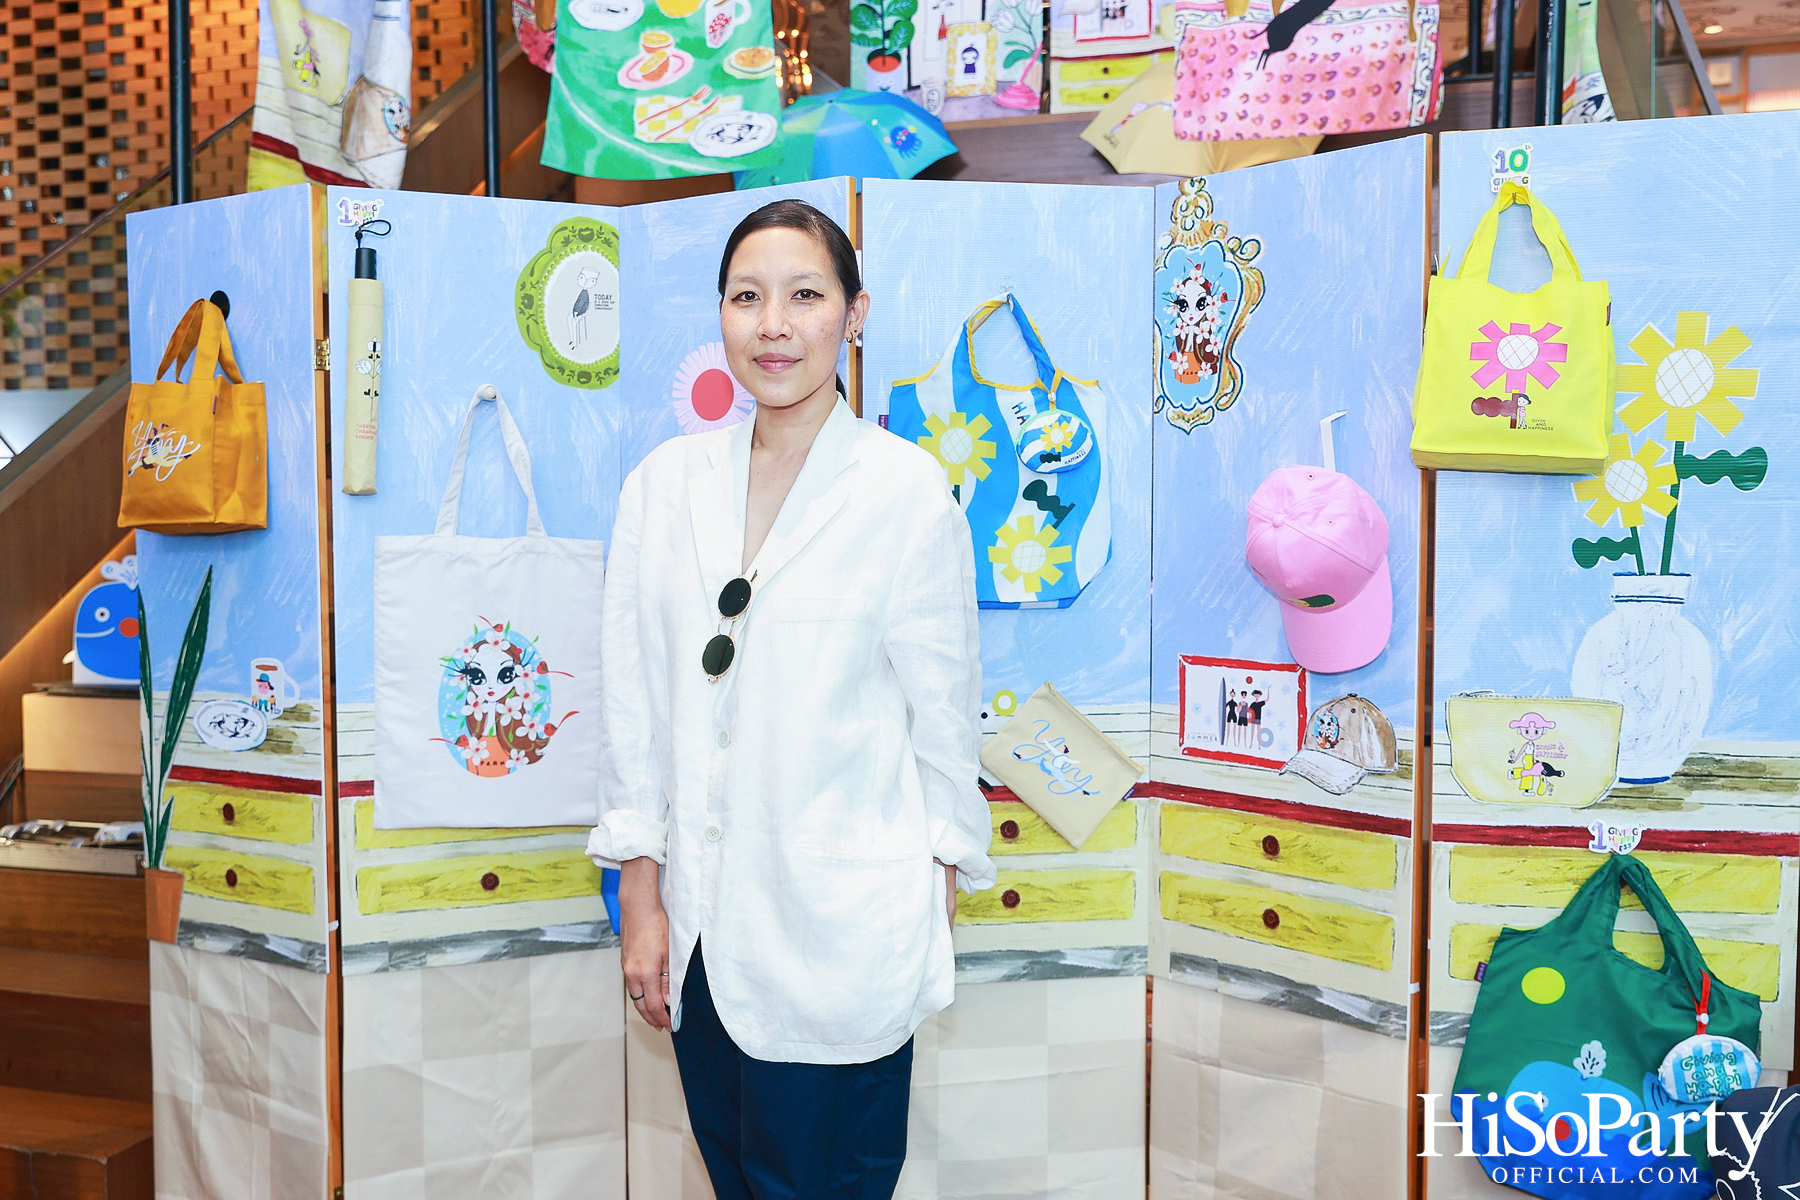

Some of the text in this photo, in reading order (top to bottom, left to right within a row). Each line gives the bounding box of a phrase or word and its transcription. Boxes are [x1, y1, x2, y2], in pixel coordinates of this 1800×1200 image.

[1494, 149, 1529, 173] 10
[594, 293, 612, 301] TODAY
[1608, 826, 1639, 837] GIVING
[1608, 835, 1636, 845] HAPPI
[1681, 1052, 1737, 1072] Giving
[1691, 1064, 1727, 1081] and
